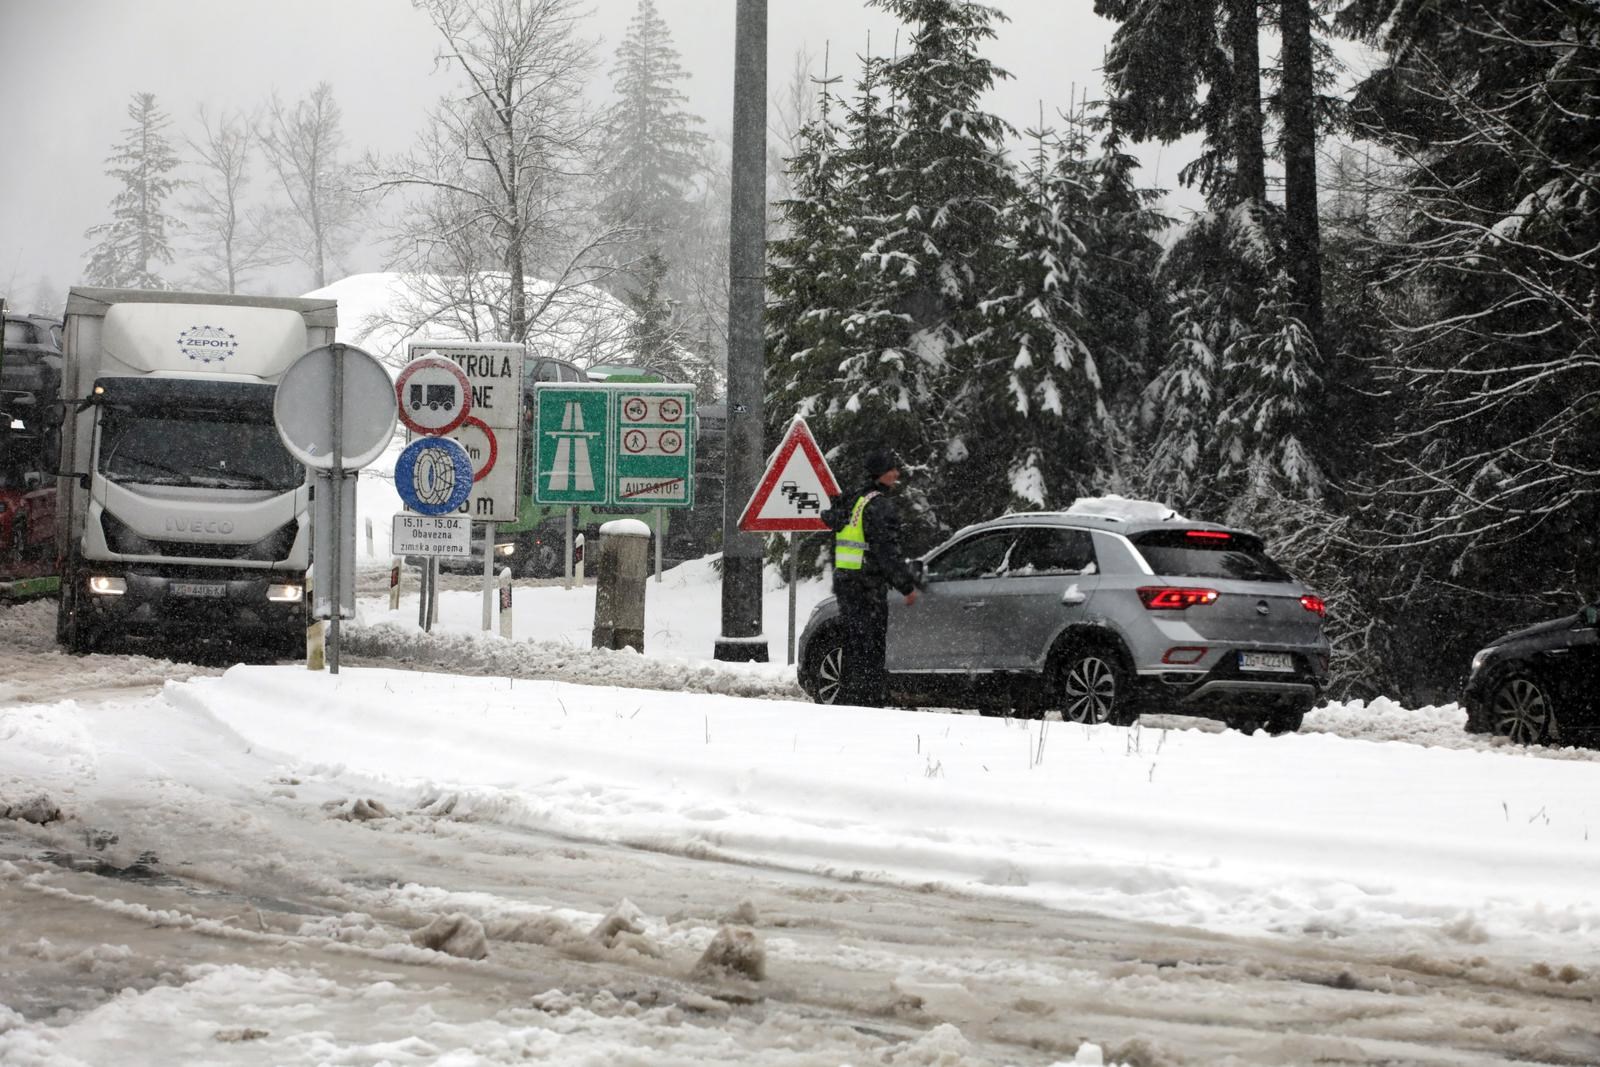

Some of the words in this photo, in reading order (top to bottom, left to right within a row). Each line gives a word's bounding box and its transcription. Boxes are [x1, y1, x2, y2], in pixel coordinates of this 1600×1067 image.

[625, 482, 680, 495] AUTOSTUP
[163, 517, 234, 536] IVECO
[412, 529, 452, 539] Obavezna
[400, 542, 430, 552] zimska
[433, 543, 464, 553] oprema
